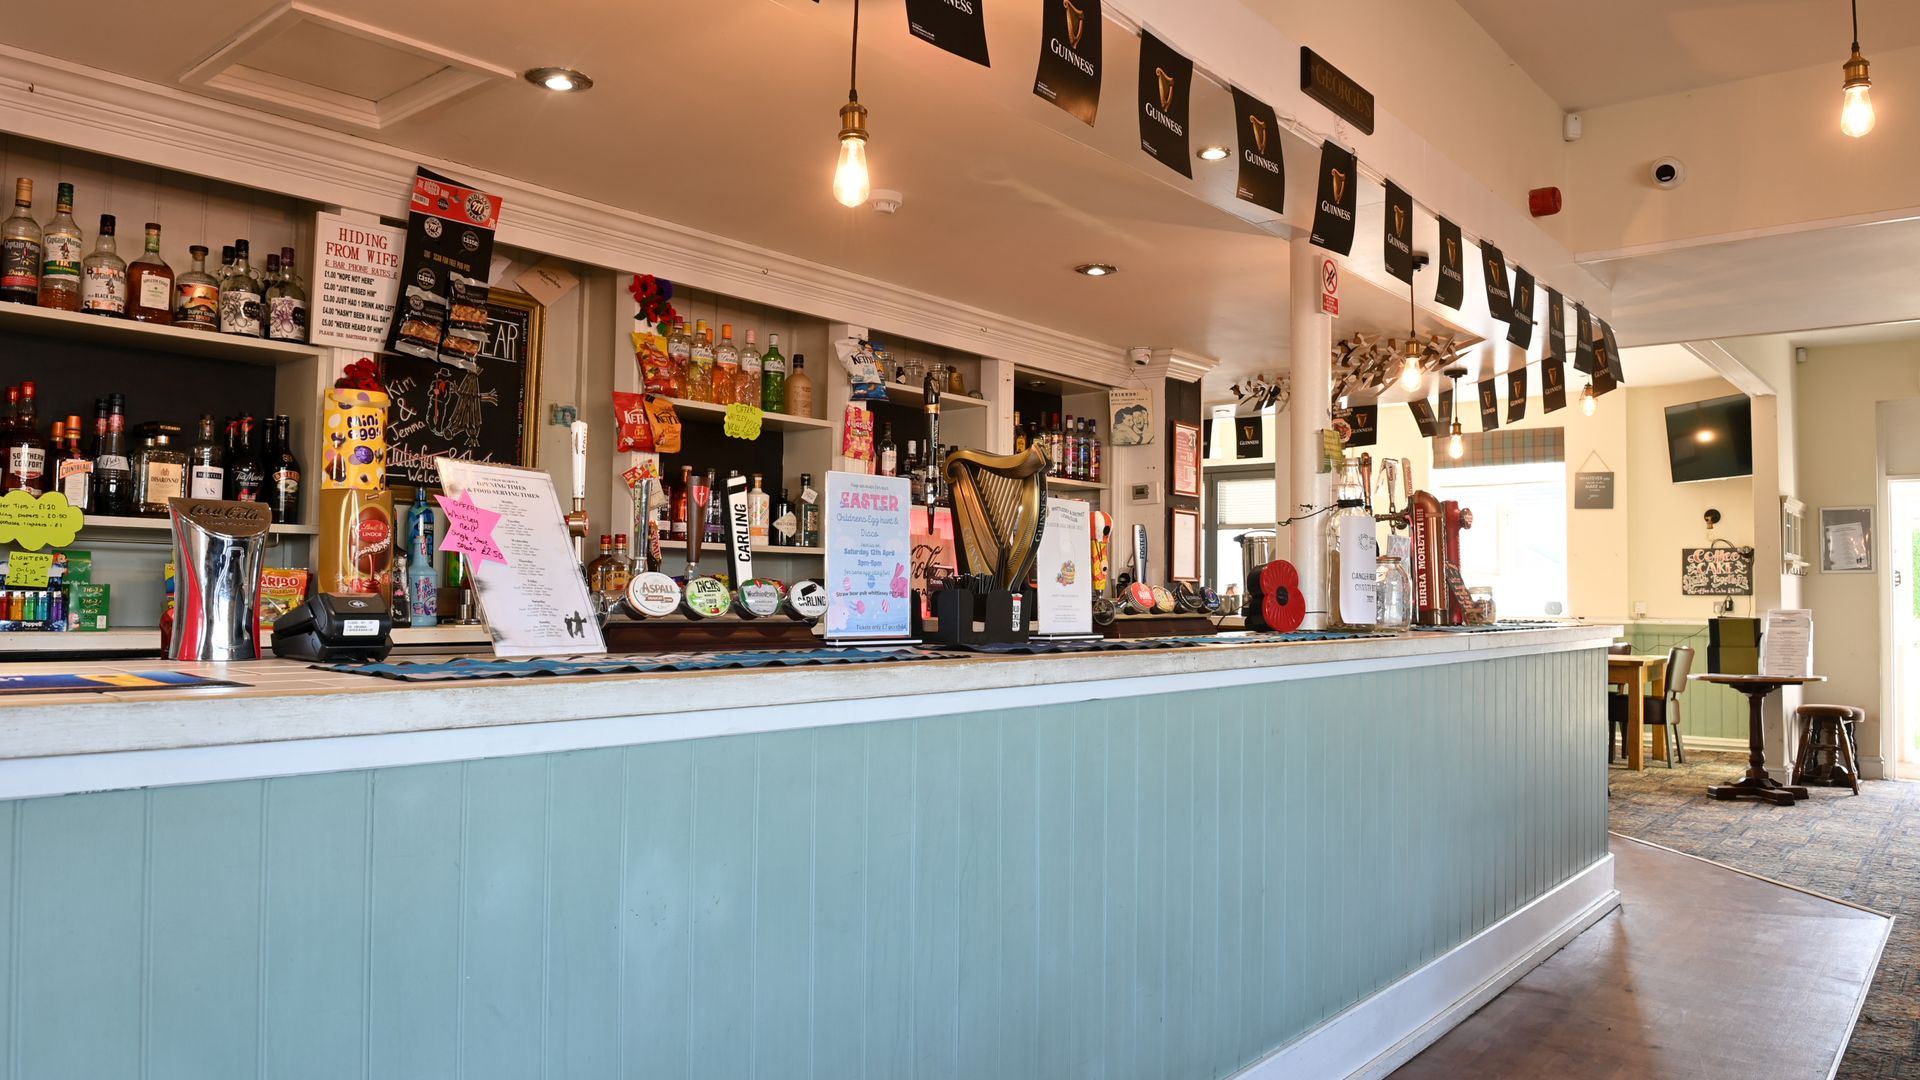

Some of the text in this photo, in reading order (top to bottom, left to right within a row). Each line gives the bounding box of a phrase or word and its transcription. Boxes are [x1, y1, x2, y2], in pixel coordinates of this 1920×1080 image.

[1050, 38, 1094, 77] GUINNESS
[1145, 102, 1183, 136] GUINNESS
[1244, 149, 1279, 174] GUINNESS
[1321, 200, 1351, 221] GUINNESS
[339, 228, 388, 249] HIDING
[463, 236, 479, 247] taste
[1387, 233, 1409, 254] GUINNESS
[326, 242, 398, 268] FROM WIFE
[333, 260, 345, 270] BAR
[349, 263, 369, 275] PHONE
[372, 267, 391, 278] RATES
[1442, 264, 1461, 282] GUINNESS
[418, 274, 435, 283] taste
[324, 282, 335, 291] £2.00
[350, 286, 366, 295] MISSED
[1488, 284, 1508, 299] GUINNESS
[336, 296, 347, 305] JUST
[348, 298, 357, 306] HAD
[361, 301, 375, 310] DRINK
[375, 303, 384, 311] AND
[322, 306, 335, 315] £4.00
[353, 310, 364, 320] BEEN
[371, 313, 380, 322] ALL
[1514, 308, 1531, 325] GUINNESS
[322, 318, 333, 327] £5.00
[351, 323, 366, 332] HEARD
[385, 376, 417, 400] Kim
[1544, 385, 1562, 396] GUINNESS
[397, 398, 417, 421] &
[347, 414, 378, 429] Mini
[347, 427, 381, 440] eggs
[386, 419, 426, 441] Jemma
[14, 461, 42, 469] COFORT
[408, 470, 440, 483] Welco
[492, 490, 520, 498] SERVING
[840, 492, 899, 511] EASTER
[1034, 490, 1046, 542] GUINNESS
[735, 503, 751, 562] CARLING
[861, 528, 879, 537] Disco
[481, 546, 503, 560] £2.50
[844, 548, 869, 557] Saturday
[1688, 549, 1740, 563] Coffee
[1416, 520, 1427, 606] BIRRA MORETTI
[1696, 562, 1734, 575] CAKE
[262, 576, 299, 587] ARIBO
[642, 583, 675, 594] ASPALL
[798, 596, 826, 607] CARLING
